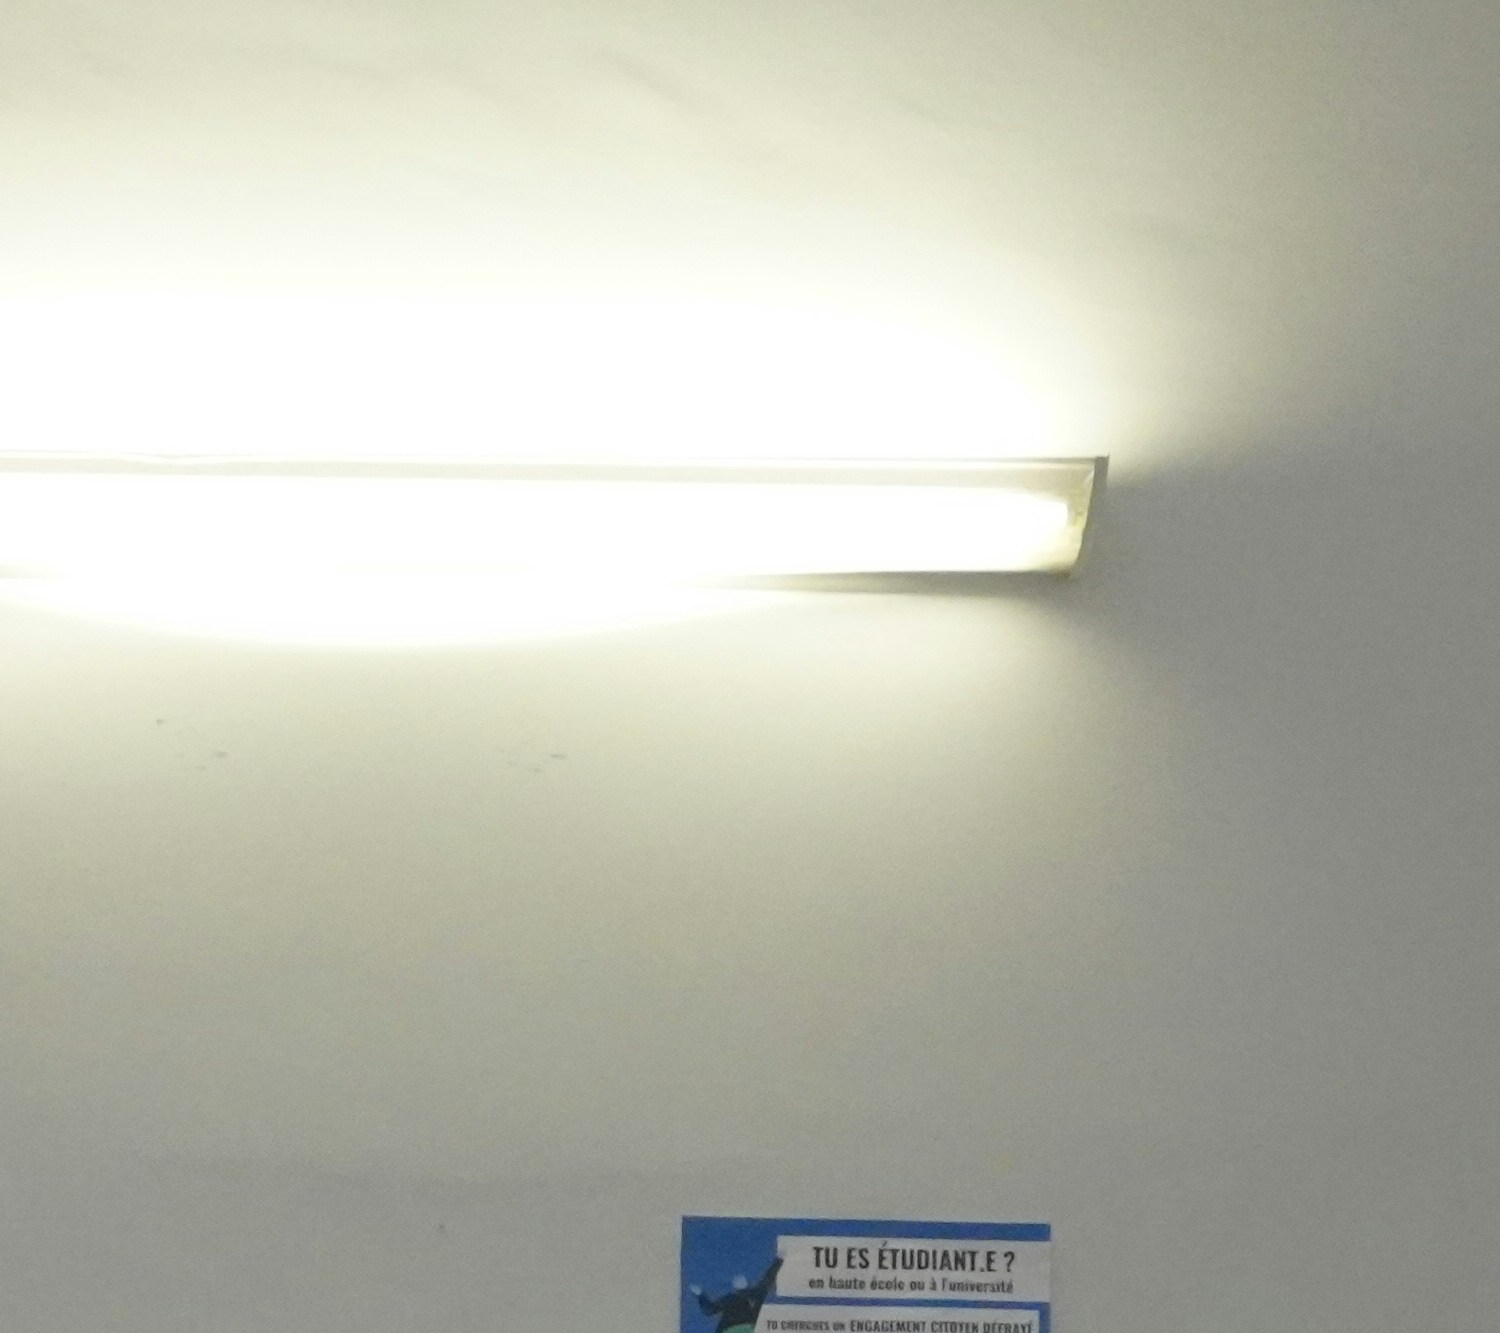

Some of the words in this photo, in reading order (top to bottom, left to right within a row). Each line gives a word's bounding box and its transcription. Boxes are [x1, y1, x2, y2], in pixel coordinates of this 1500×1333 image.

[812, 1246, 838, 1268] TU
[849, 1247, 870, 1270] ES
[877, 1241, 997, 1272] ÉTUDIANT.E
[1003, 1251, 1015, 1272] ?
[809, 1279, 824, 1289] en
[829, 1276, 865, 1290] haute
[870, 1276, 904, 1291] école
[910, 1279, 925, 1291] ou
[929, 1276, 937, 1291] à
[850, 1320, 926, 1333] ENGAGEMENT
[931, 1321, 979, 1333] CITOYEN
